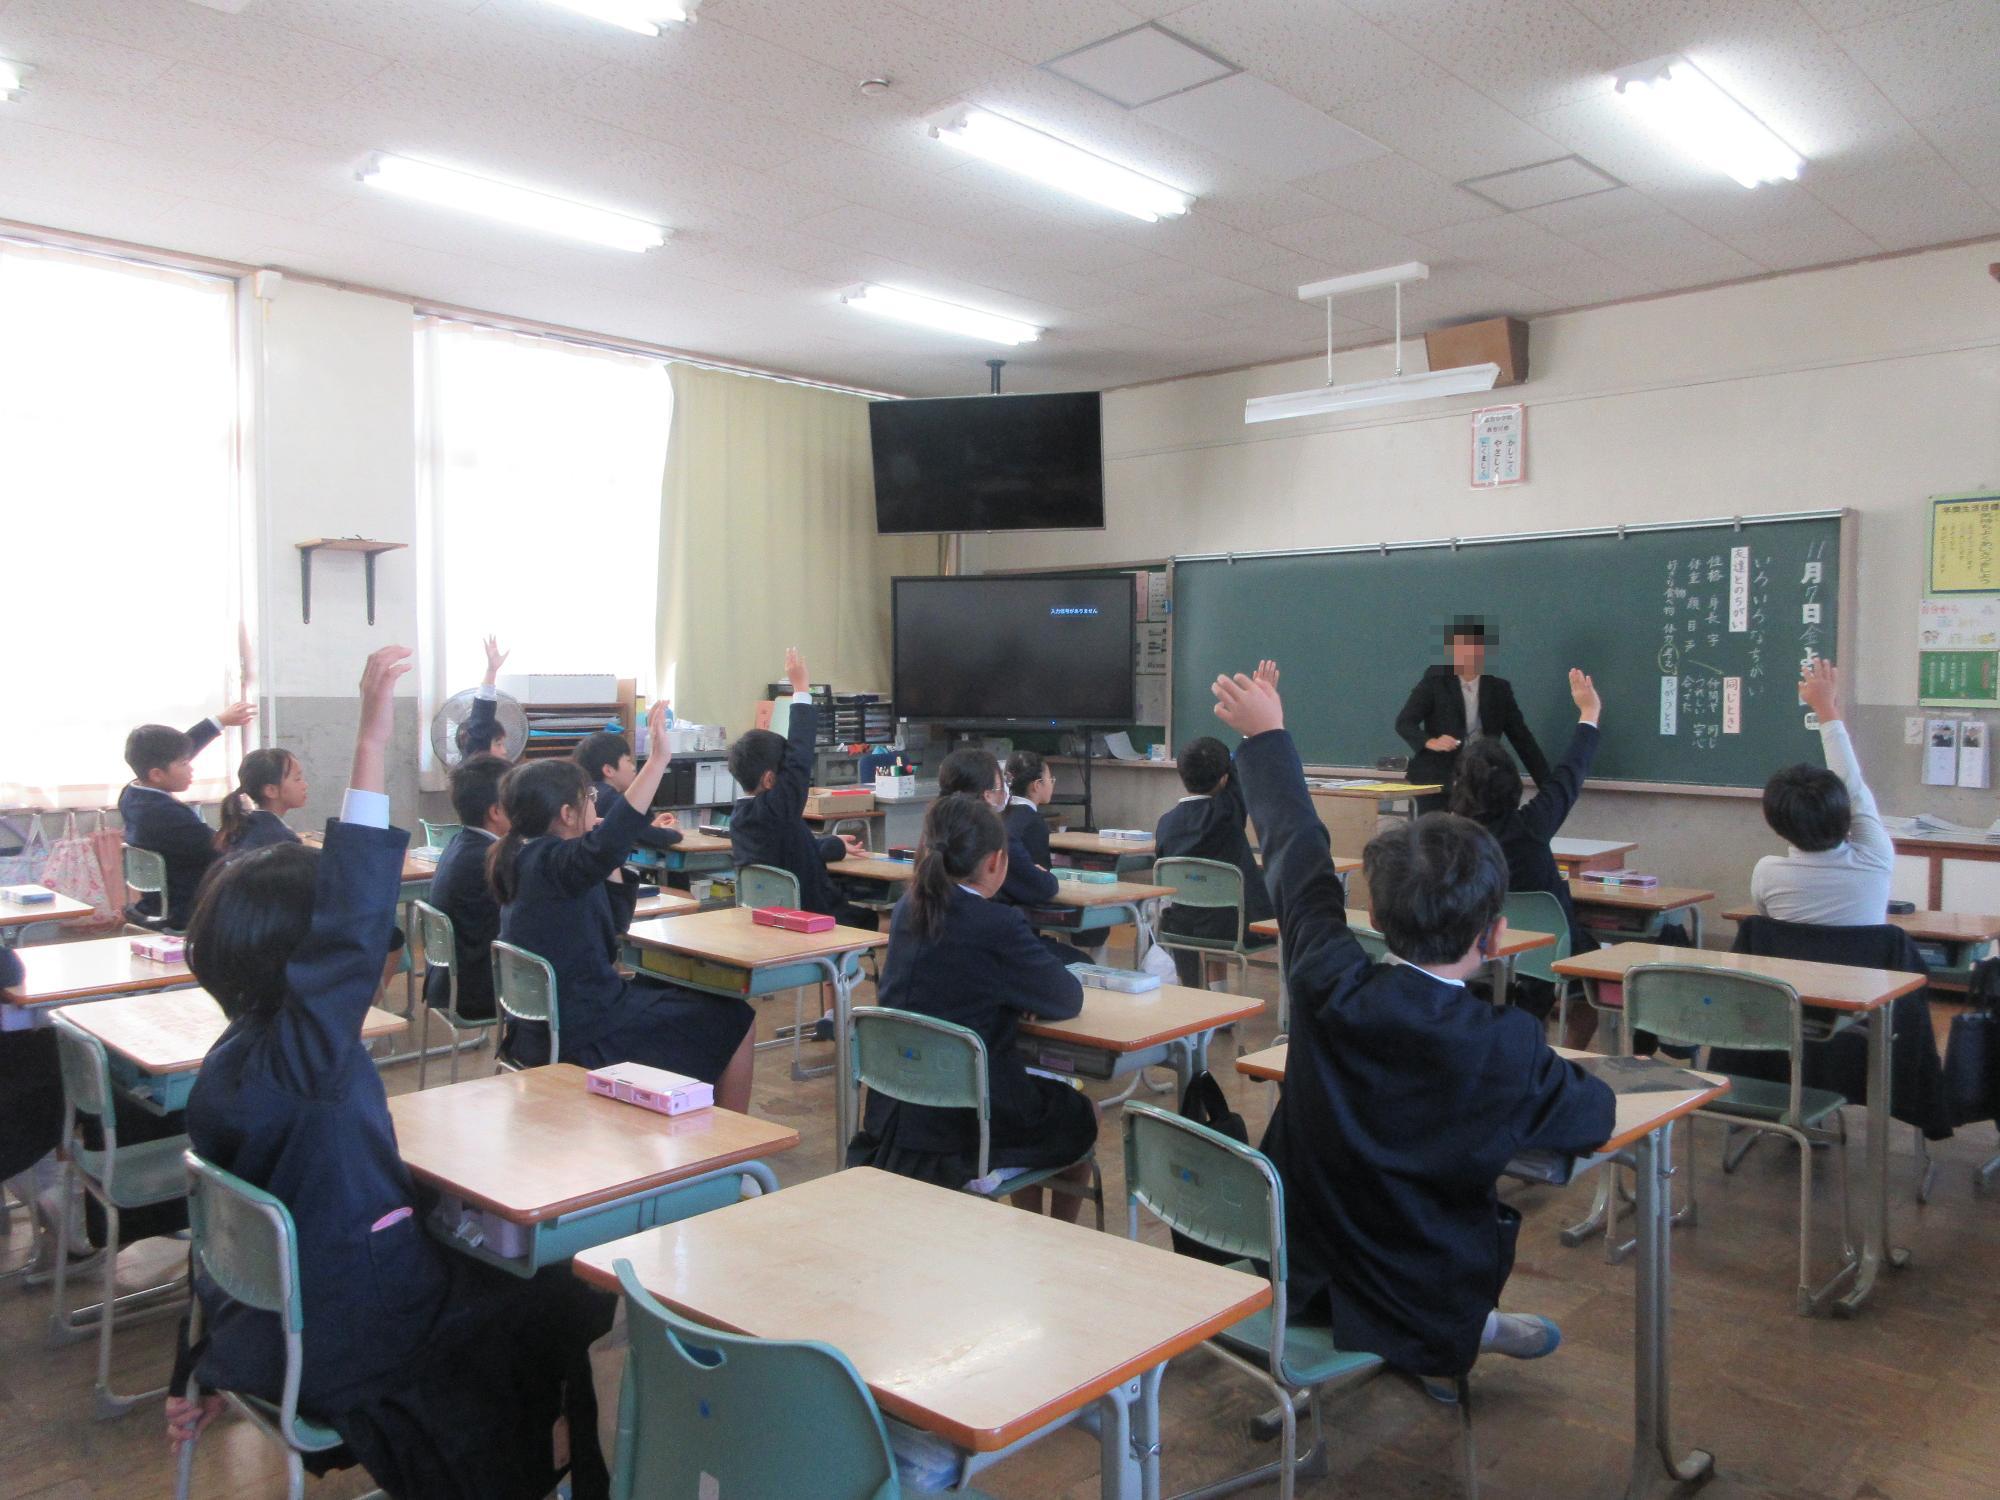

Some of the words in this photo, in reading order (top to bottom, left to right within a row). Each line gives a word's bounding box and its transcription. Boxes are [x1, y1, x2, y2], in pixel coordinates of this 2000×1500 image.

[1494, 440, 1502, 474] やさしく
[1506, 440, 1515, 473] かしこく
[1704, 594, 1721, 624] 身長
[1733, 548, 1747, 630] 友達とのちがい
[1050, 608, 1098, 616] 入力信号がありません
[1748, 556, 1770, 696] いろいろなちがい
[1663, 679, 1676, 733] ちがうとき
[1726, 679, 1738, 729] 同じとき
